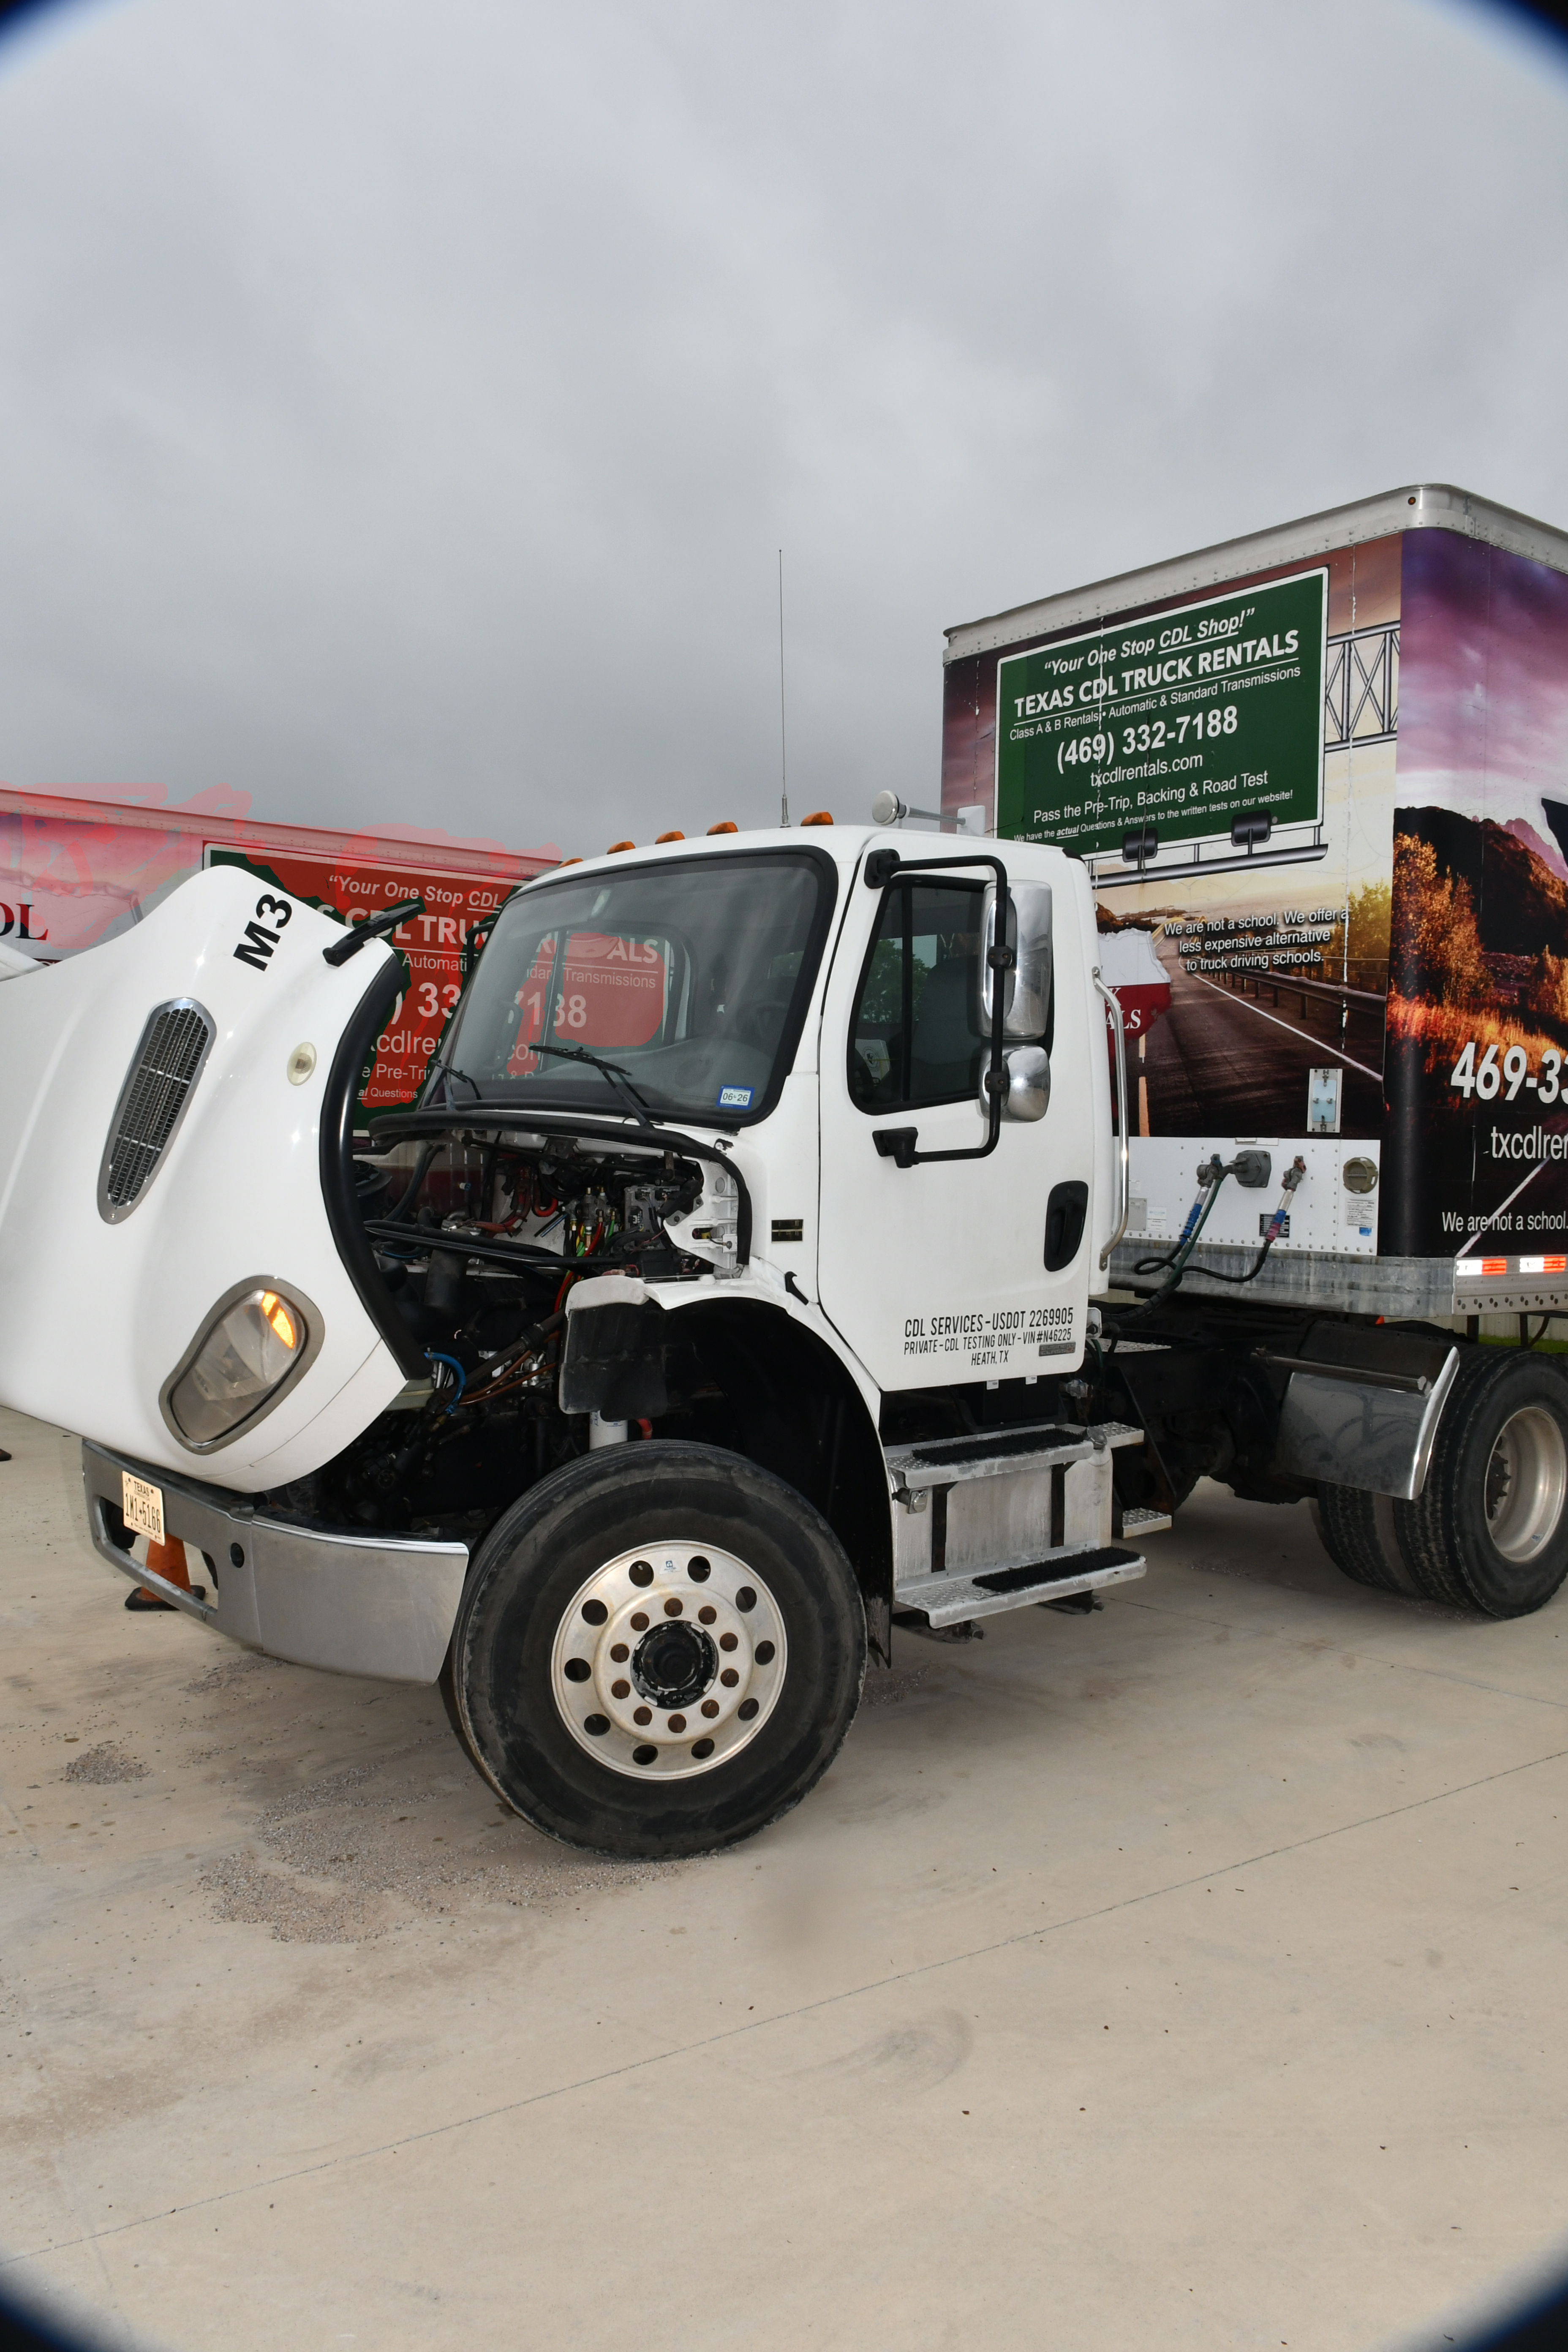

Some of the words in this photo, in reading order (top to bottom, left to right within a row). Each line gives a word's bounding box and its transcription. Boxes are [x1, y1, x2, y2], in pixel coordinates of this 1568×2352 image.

[1087, 648, 1116, 667] One
[1121, 638, 1155, 658] Stop
[1160, 625, 1192, 648] CDL
[1014, 686, 1074, 717] TEXAS
[1079, 675, 1118, 702] CDL
[1122, 656, 1193, 692] TRUCK
[1198, 629, 1299, 675] RENTALS
[1010, 727, 1034, 740] Class
[1036, 724, 1043, 735] A
[1045, 721, 1052, 732] &
[1054, 719, 1061, 731] B
[1108, 698, 1157, 719] Automatic
[1160, 695, 1168, 707] &
[1170, 683, 1218, 705] Standard
[1220, 667, 1301, 693] Transmissions
[1057, 732, 1114, 774] (469)
[1122, 705, 1238, 754] 332-7188
[1090, 754, 1203, 787] txcdlrentals.com
[1034, 809, 1061, 824] Pass
[1064, 804, 1081, 818] the
[1084, 796, 1133, 815] Pre-Trip,
[1137, 787, 1185, 806] Backing
[1189, 782, 1199, 797] &
[1203, 775, 1237, 795] Road
[1240, 770, 1269, 788] Test
[1014, 834, 1025, 842] We
[1026, 832, 1043, 841] have
[1044, 829, 1055, 838] the
[1056, 824, 1079, 837] actual
[1080, 820, 1116, 833] Questions
[1117, 818, 1123, 826] &
[1124, 813, 1156, 825] Answers
[1157, 811, 1165, 820] to
[1167, 808, 1179, 818] the
[1181, 805, 1207, 817] written
[1209, 801, 1228, 812] tests
[1230, 800, 1240, 808] on
[1242, 797, 1256, 807] our
[1258, 789, 1293, 804] website!
[385, 882, 419, 899] One
[424, 885, 463, 907] Stop
[468, 890, 502, 908] CDL
[233, 894, 292, 972] M3
[1164, 922, 1183, 936] We
[1186, 922, 1204, 934] are
[1207, 918, 1225, 932] not
[1228, 920, 1235, 930] a
[1238, 912, 1279, 929] school.
[1284, 910, 1305, 924] We
[1309, 908, 1338, 922] offer
[1341, 909, 1349, 920] a
[1179, 940, 1201, 953] less
[1205, 934, 1262, 953] expensive
[1265, 929, 1331, 946] alternative
[402, 953, 467, 972] Automati
[1186, 959, 1197, 971] to
[1200, 956, 1228, 970] truck
[1230, 953, 1269, 969] driving
[1272, 949, 1324, 965] schools.
[563, 967, 656, 988] Transmissions
[376, 1063, 430, 1080] Pre-Tri
[1450, 1042, 1568, 1105] 469-3
[370, 1087, 418, 1098] Questions
[1442, 1211, 1464, 1232] We
[1467, 1215, 1488, 1232] are
[1492, 1212, 1513, 1231] not
[1516, 1215, 1524, 1230] a
[1527, 1210, 1568, 1230] school.
[905, 1318, 926, 1337] CDL
[1029, 1307, 1073, 1327] 2269905
[963, 1334, 995, 1350] TESTING
[971, 1350, 997, 1366] HEATH,
[999, 1350, 1009, 1363] TX
[133, 1481, 150, 1497] TEXAS
